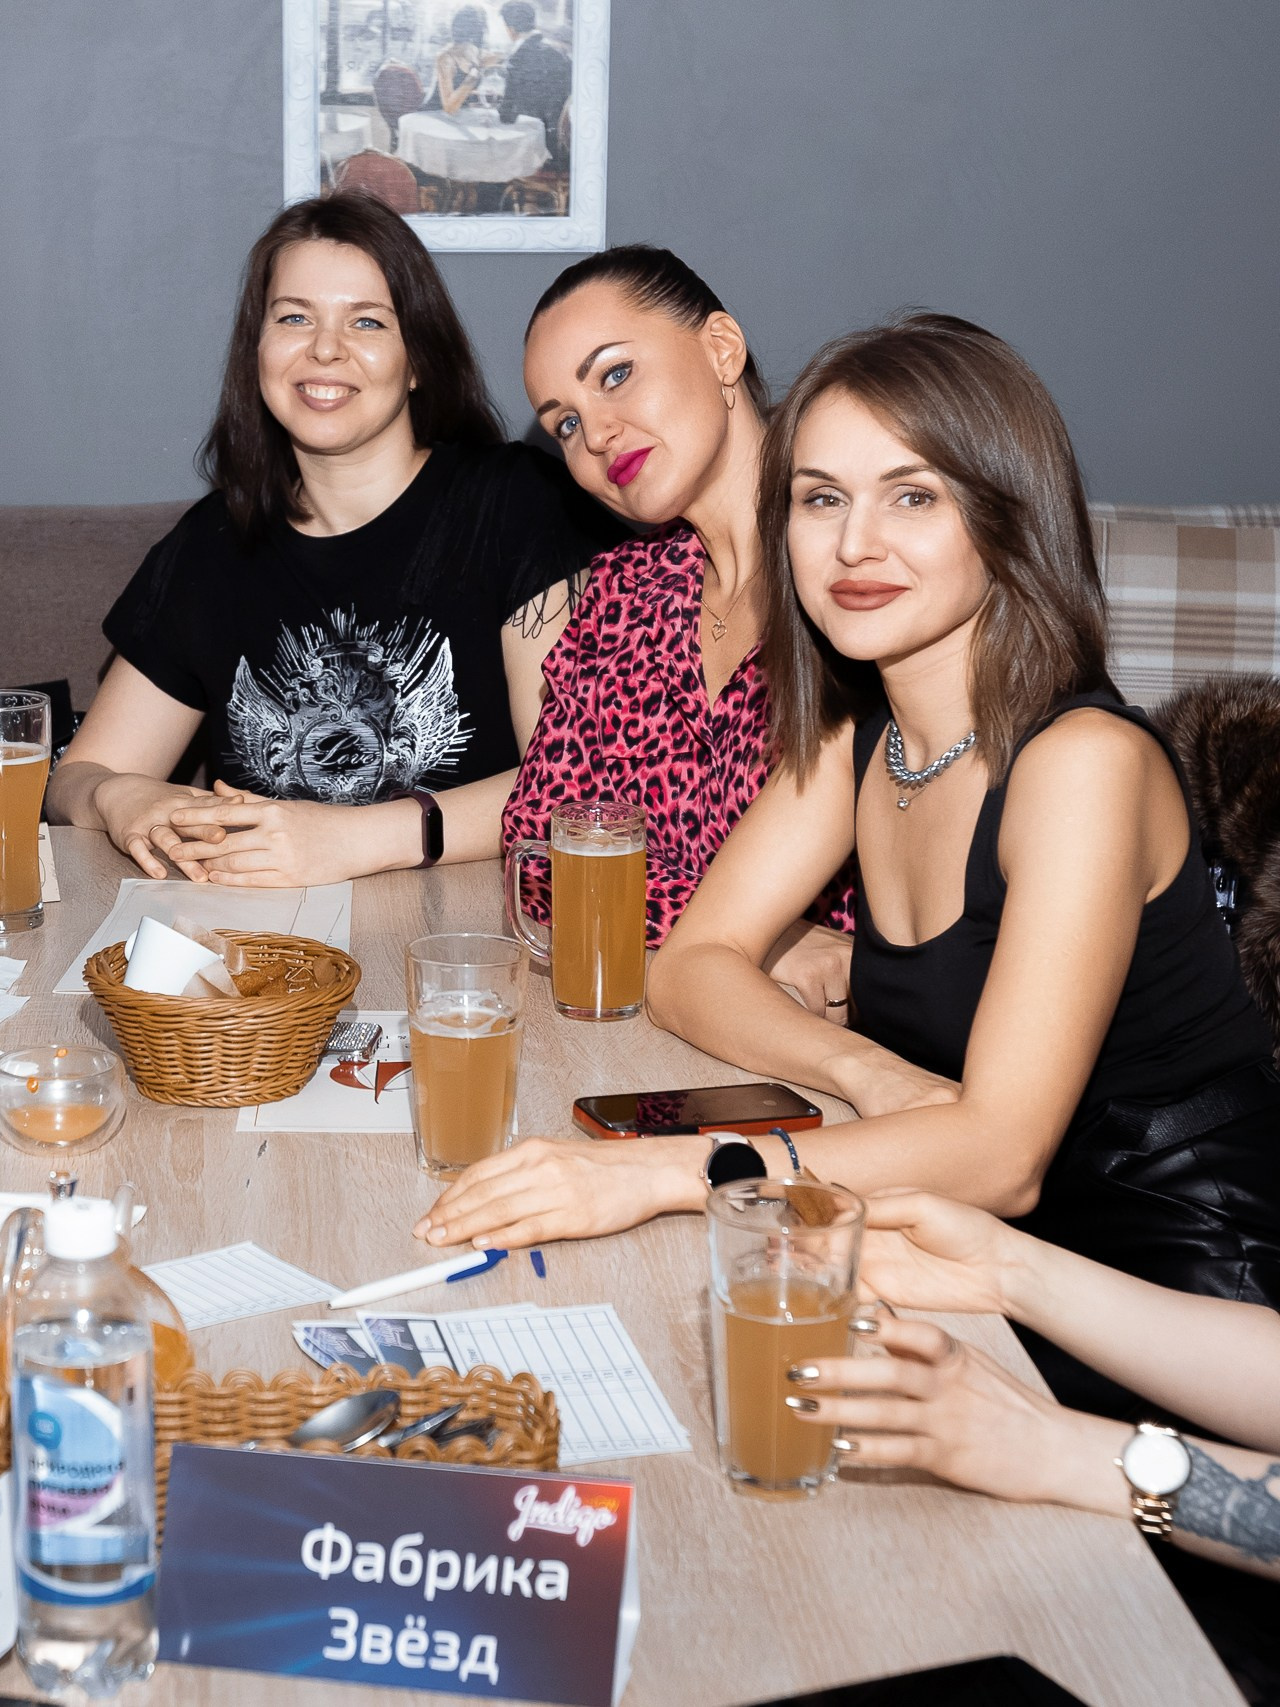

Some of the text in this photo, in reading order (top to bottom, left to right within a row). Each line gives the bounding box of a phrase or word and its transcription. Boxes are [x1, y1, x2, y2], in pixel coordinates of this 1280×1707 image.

[304, 732, 375, 766] Love
[507, 1484, 617, 1547] Indigo
[300, 1522, 570, 1602] Фабрика
[322, 1606, 500, 1687] Звёзд
